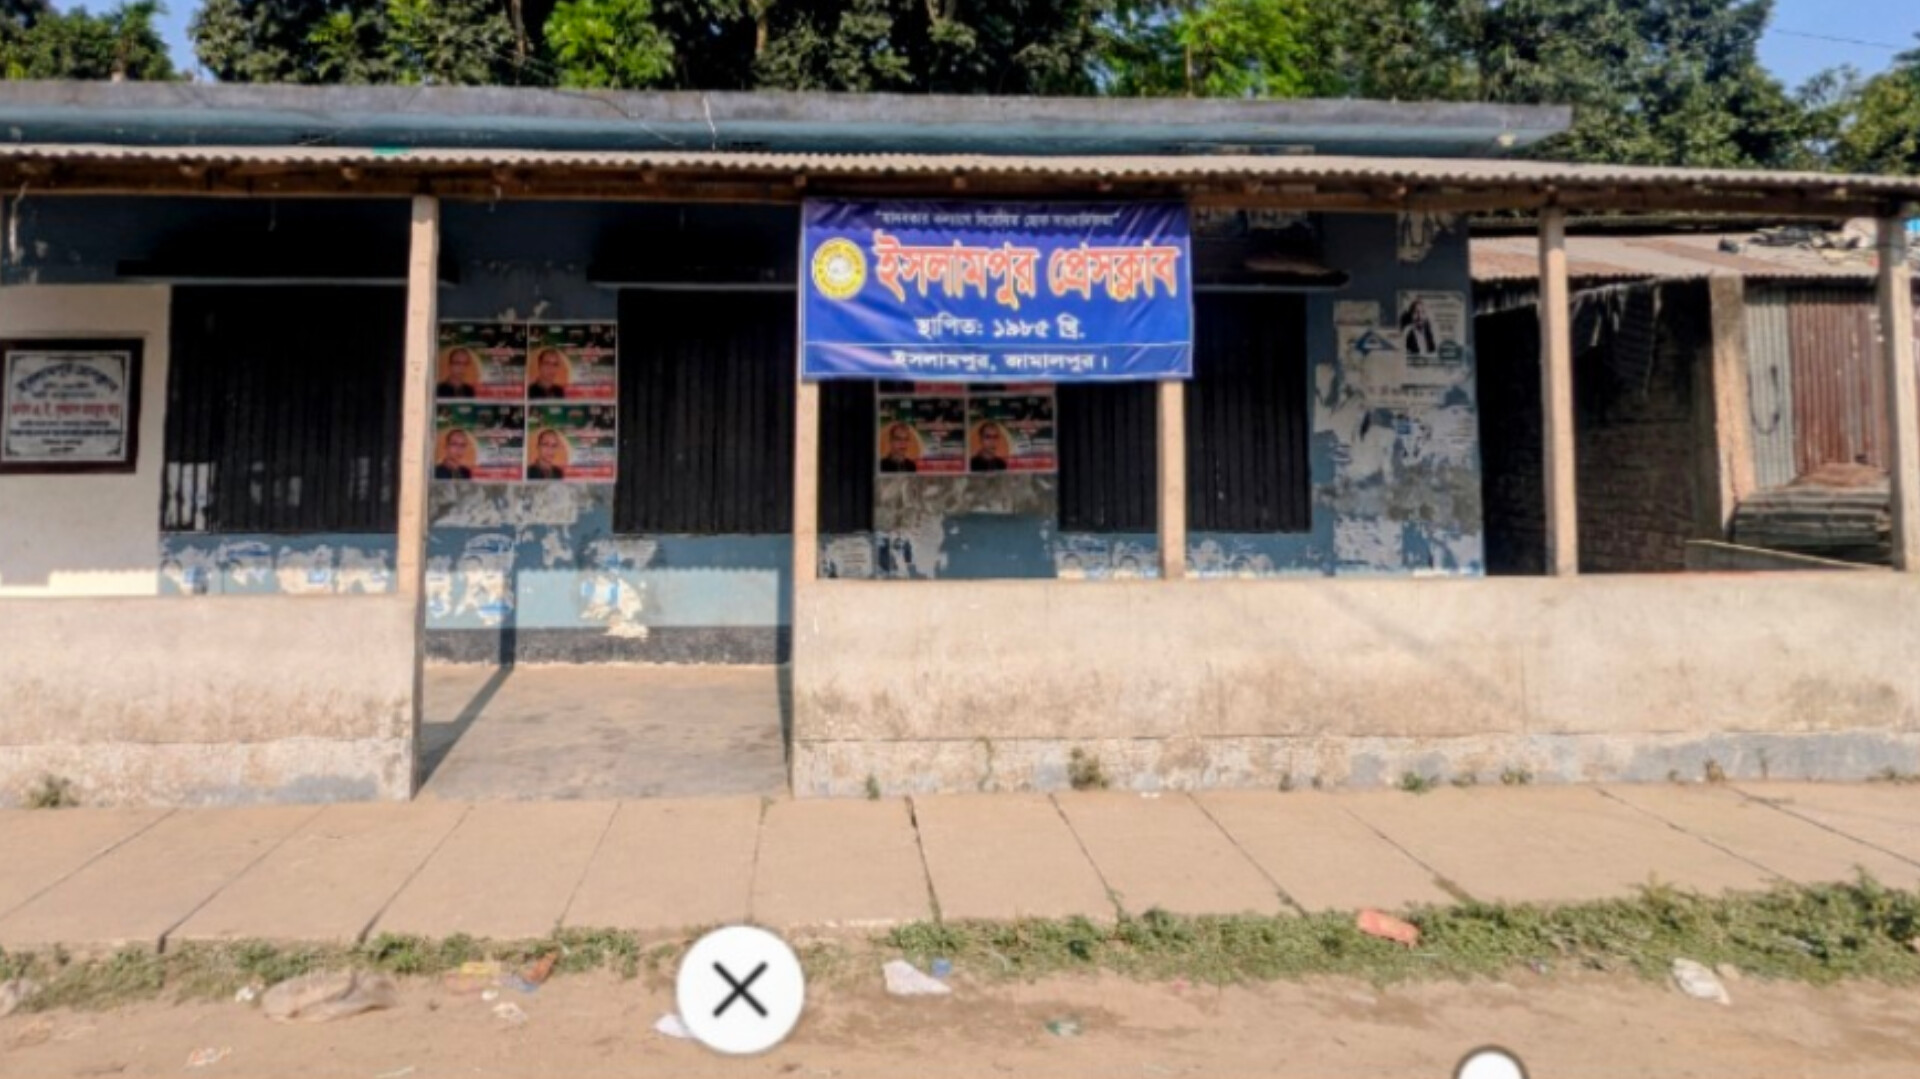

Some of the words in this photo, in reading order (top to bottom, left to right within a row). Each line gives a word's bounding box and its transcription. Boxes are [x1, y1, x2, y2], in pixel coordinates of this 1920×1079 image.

[873, 228, 1042, 311] ইসলামপুর
[1047, 239, 1182, 302] প্রেসক্লাব
[914, 311, 984, 340] স্থাপিত:
[993, 318, 1049, 339] ১৯৮৫
[891, 349, 997, 372] ইসলামপুর,
